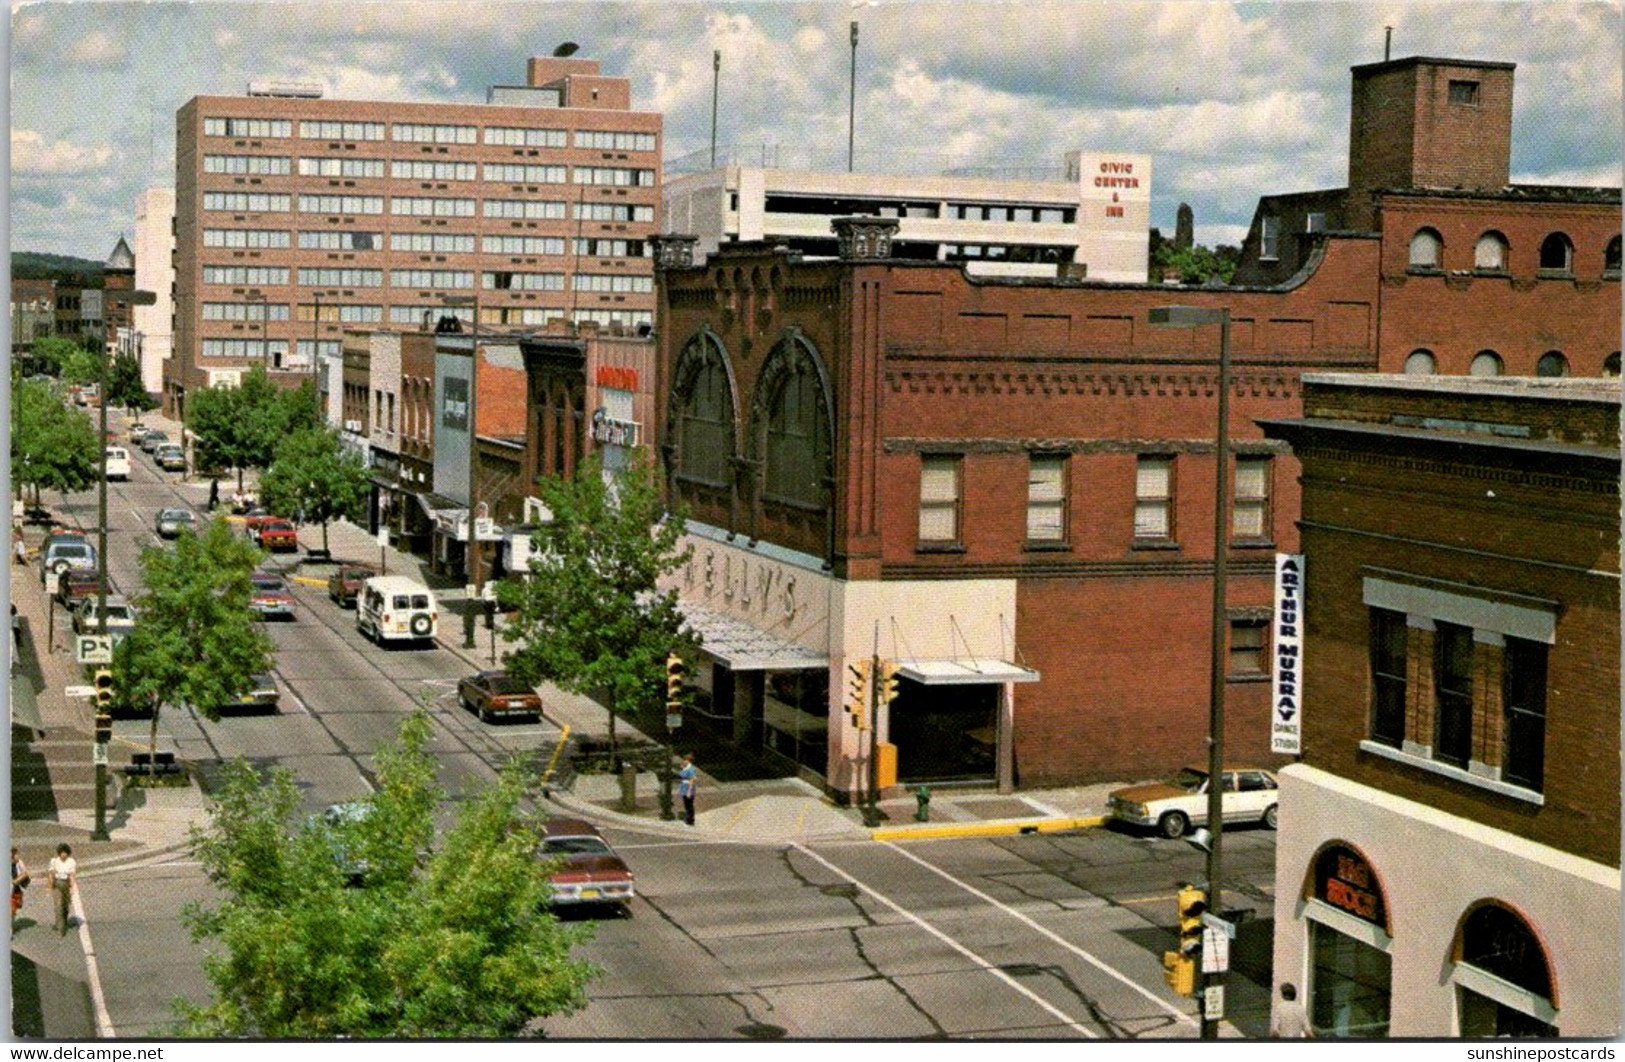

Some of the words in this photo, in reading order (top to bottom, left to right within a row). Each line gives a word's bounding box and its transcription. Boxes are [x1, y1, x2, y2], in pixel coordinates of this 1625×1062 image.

[1100, 162, 1132, 173] CIVIC
[1094, 177, 1138, 187] CENTER
[1105, 206, 1123, 217] INN
[1280, 560, 1298, 637] ARTHUR
[81, 639, 97, 659] P
[1277, 644, 1298, 721] MURRAY
[1274, 723, 1298, 735] DANCE
[1274, 738, 1298, 750] STUDIO
